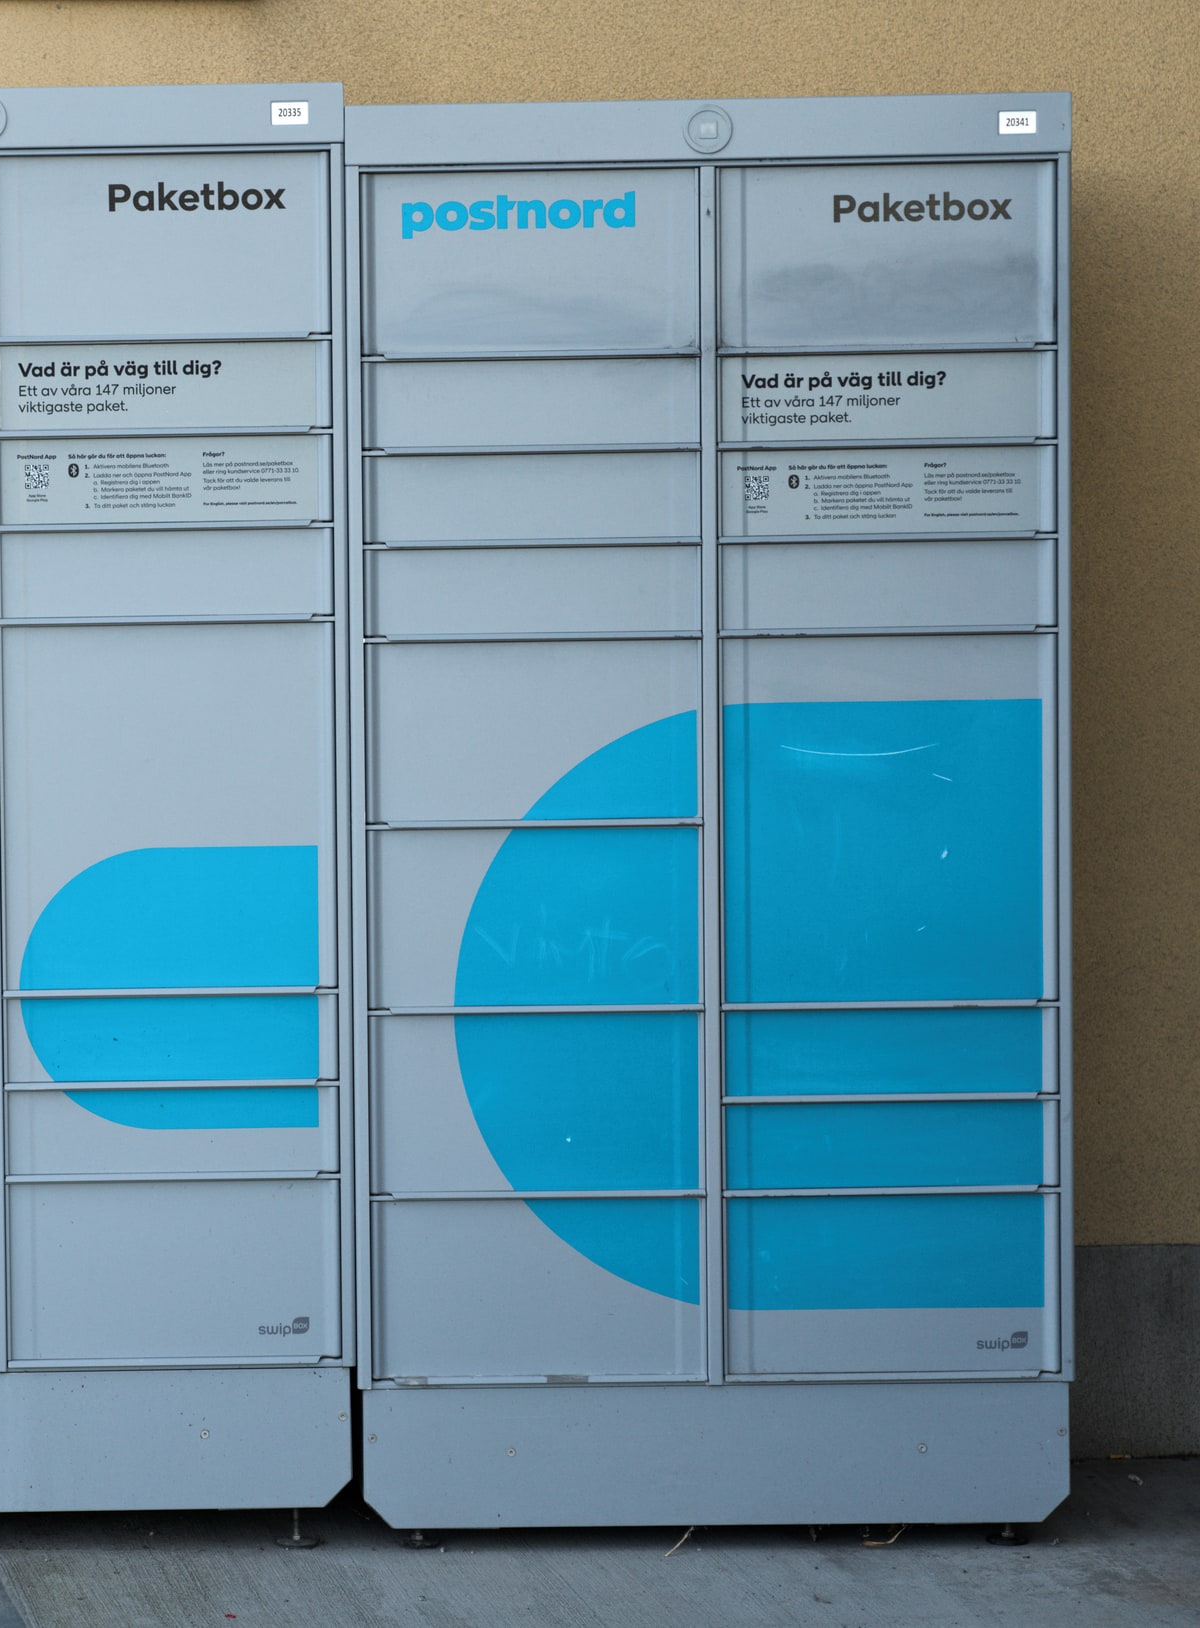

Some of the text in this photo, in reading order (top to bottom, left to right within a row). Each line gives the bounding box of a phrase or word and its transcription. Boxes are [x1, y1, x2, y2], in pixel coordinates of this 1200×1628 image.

[278, 108, 301, 117] 20335
[1006, 118, 1029, 126] 20341
[108, 181, 286, 212] Paketbox
[402, 191, 636, 239] postnord
[833, 192, 1012, 223] Paketbox
[18, 360, 222, 380] Vad är på väg till dig?
[741, 371, 946, 391] Vad är på väg till dig?
[19, 384, 176, 397] Ett av våra 147 miljoner
[18, 400, 128, 415] viktigaste paket.
[742, 395, 901, 408] Ett av våra 147 miljoner
[741, 411, 852, 426] viktigaste paket.
[258, 1323, 291, 1337] swip
[976, 1337, 1009, 1352] swip
